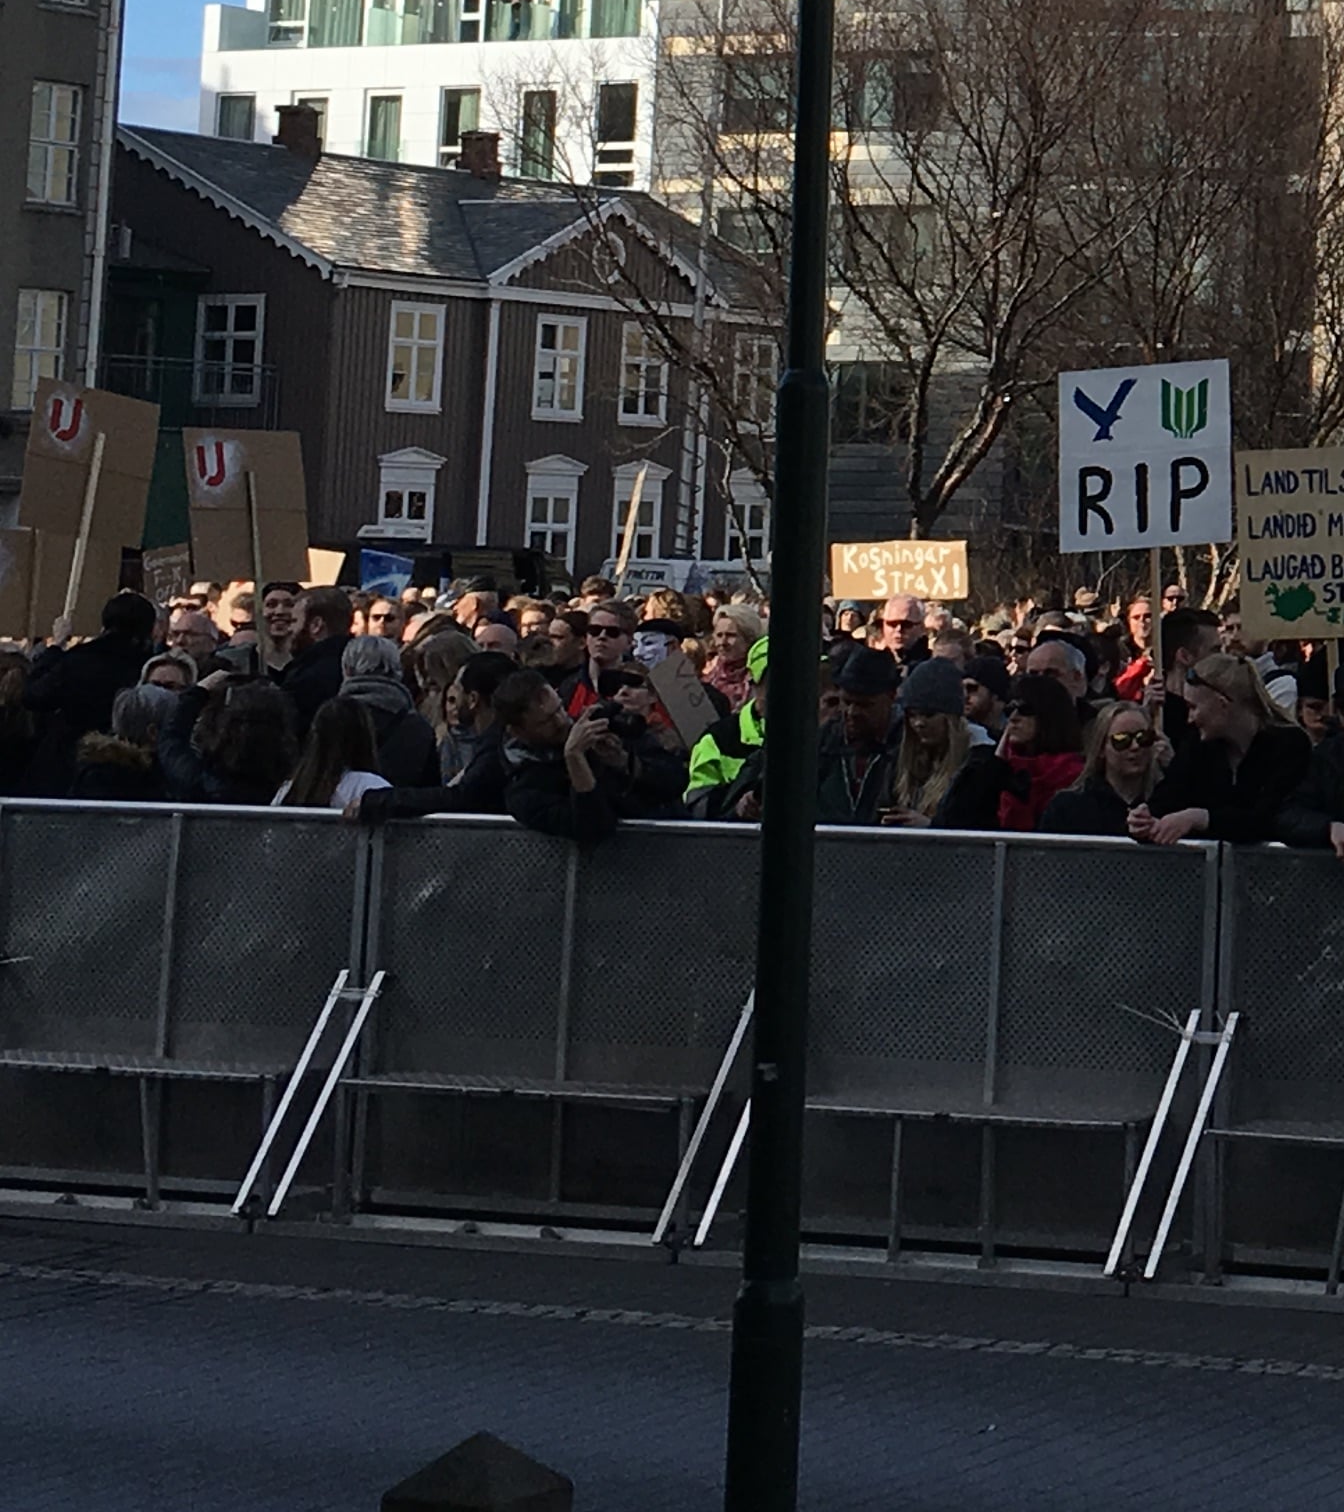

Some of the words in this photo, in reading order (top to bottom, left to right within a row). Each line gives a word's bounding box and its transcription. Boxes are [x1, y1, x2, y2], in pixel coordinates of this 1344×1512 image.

[1078, 456, 1210, 535] RIP
[1246, 464, 1299, 496] LAND
[1301, 468, 1338, 495] TIL
